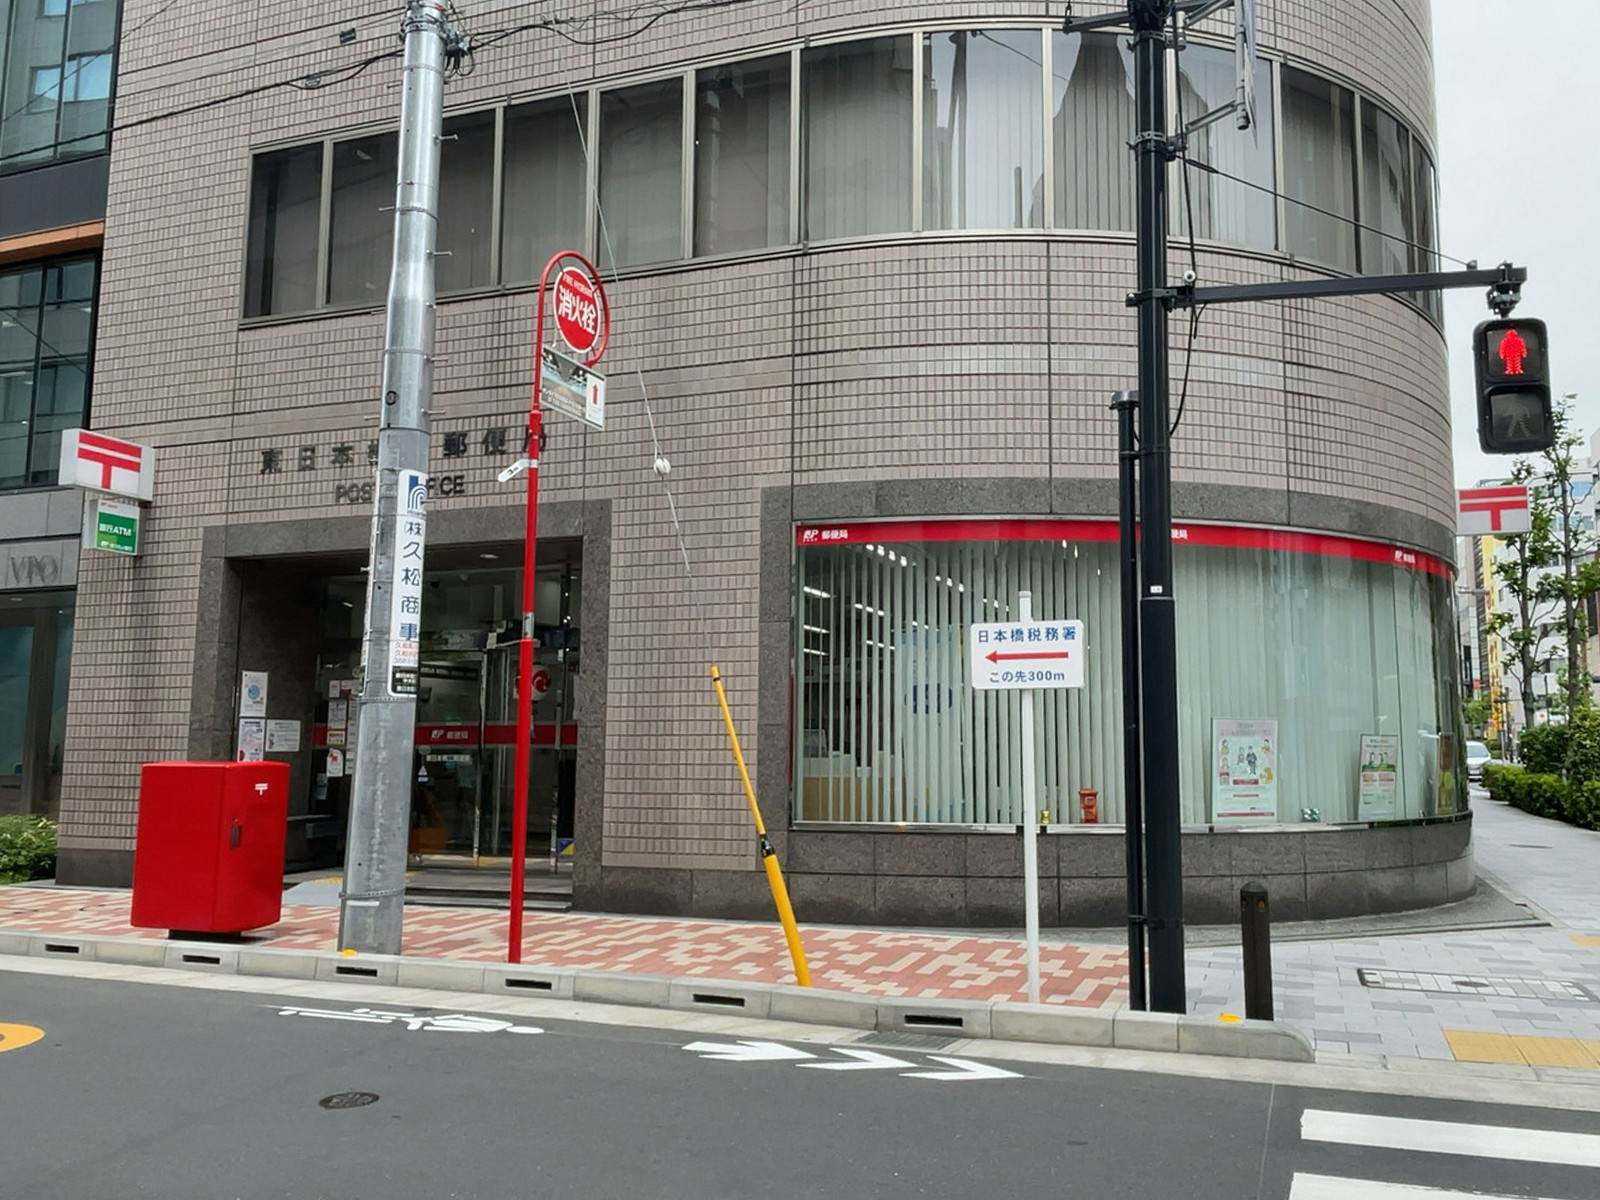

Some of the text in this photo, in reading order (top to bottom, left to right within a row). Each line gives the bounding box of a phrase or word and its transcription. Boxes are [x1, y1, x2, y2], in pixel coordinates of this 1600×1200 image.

[558, 284, 597, 335] 消火栓
[977, 626, 1078, 644] 日本橋税務署
[989, 670, 1066, 684] この先300m
